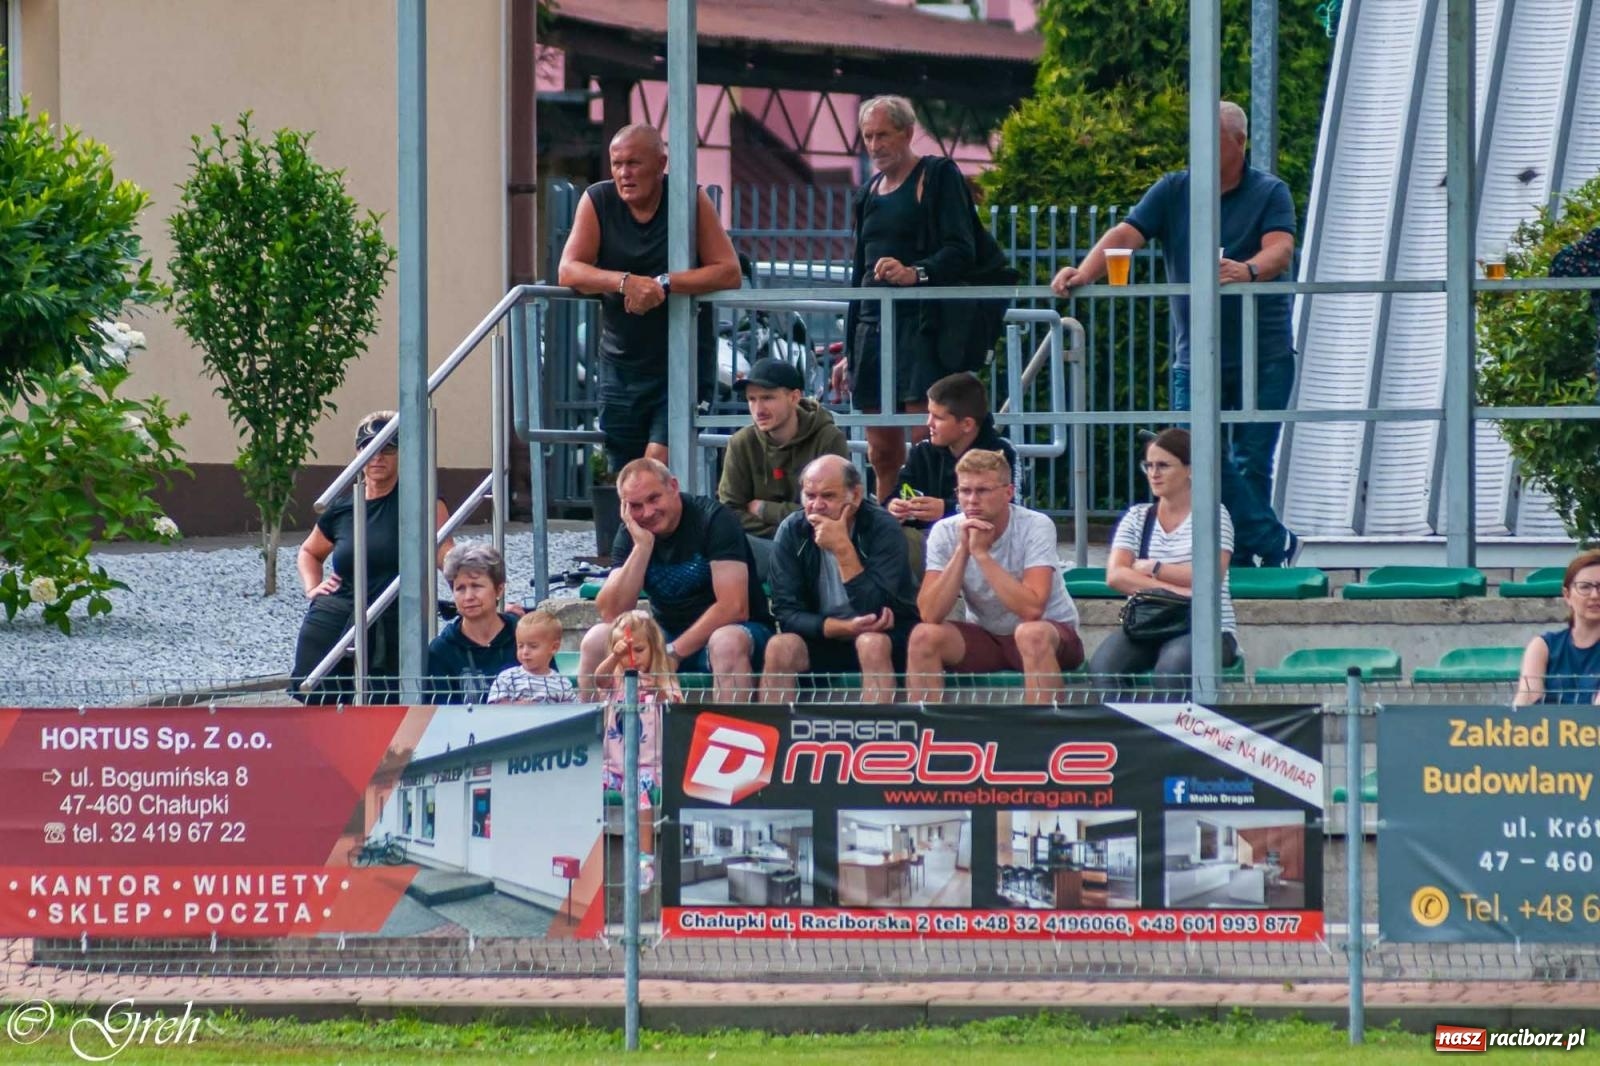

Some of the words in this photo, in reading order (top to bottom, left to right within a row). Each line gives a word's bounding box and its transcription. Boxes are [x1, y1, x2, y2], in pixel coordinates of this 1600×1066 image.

[41, 727, 149, 750] HORTUS
[157, 727, 196, 754] Sp.
[203, 727, 220, 749] Z
[227, 731, 272, 749] o.o.
[791, 720, 918, 740] DRAGAN
[1449, 718, 1549, 747] Zakład
[1559, 719, 1600, 747] Re
[507, 745, 589, 775] HORTUS
[1175, 712, 1235, 751] KUCHNIE
[1238, 741, 1257, 763] NA
[1261, 751, 1317, 790] WYMIAR
[70, 767, 94, 787] ul.
[101, 766, 229, 792] Bogumińska
[235, 766, 249, 787] 8
[1423, 765, 1594, 801] Budowlany
[59, 794, 132, 815] 47-460
[139, 794, 229, 819] Chałupki
[883, 788, 1114, 808] www.mebledragan.pl
[73, 822, 103, 843] tel.
[110, 822, 136, 843] 32
[142, 822, 181, 843] 419
[187, 822, 212, 843] 67
[220, 822, 246, 843] 22
[1503, 816, 1537, 838] ul.
[1479, 851, 1509, 872] 47
[1545, 851, 1593, 872] 460
[30, 875, 161, 896] KANTOR
[193, 874, 329, 895] WINIETY
[48, 902, 151, 924] SKLEP
[184, 902, 311, 924] POCZTA
[1460, 893, 1508, 922] Tel.
[1519, 894, 1574, 922] +48
[680, 911, 764, 932] Chałupki
[770, 912, 795, 930] ul.
[801, 913, 912, 931] Raciborska
[917, 915, 930, 931] 2
[935, 914, 967, 932] tel:
[973, 915, 1009, 932] +48
[1015, 915, 1040, 932] 32
[1045, 915, 1133, 935] 4196066,
[1138, 915, 1175, 933] +48
[1182, 915, 1216, 933] 601
[1222, 915, 1259, 933] 993
[1264, 915, 1301, 933] 877
